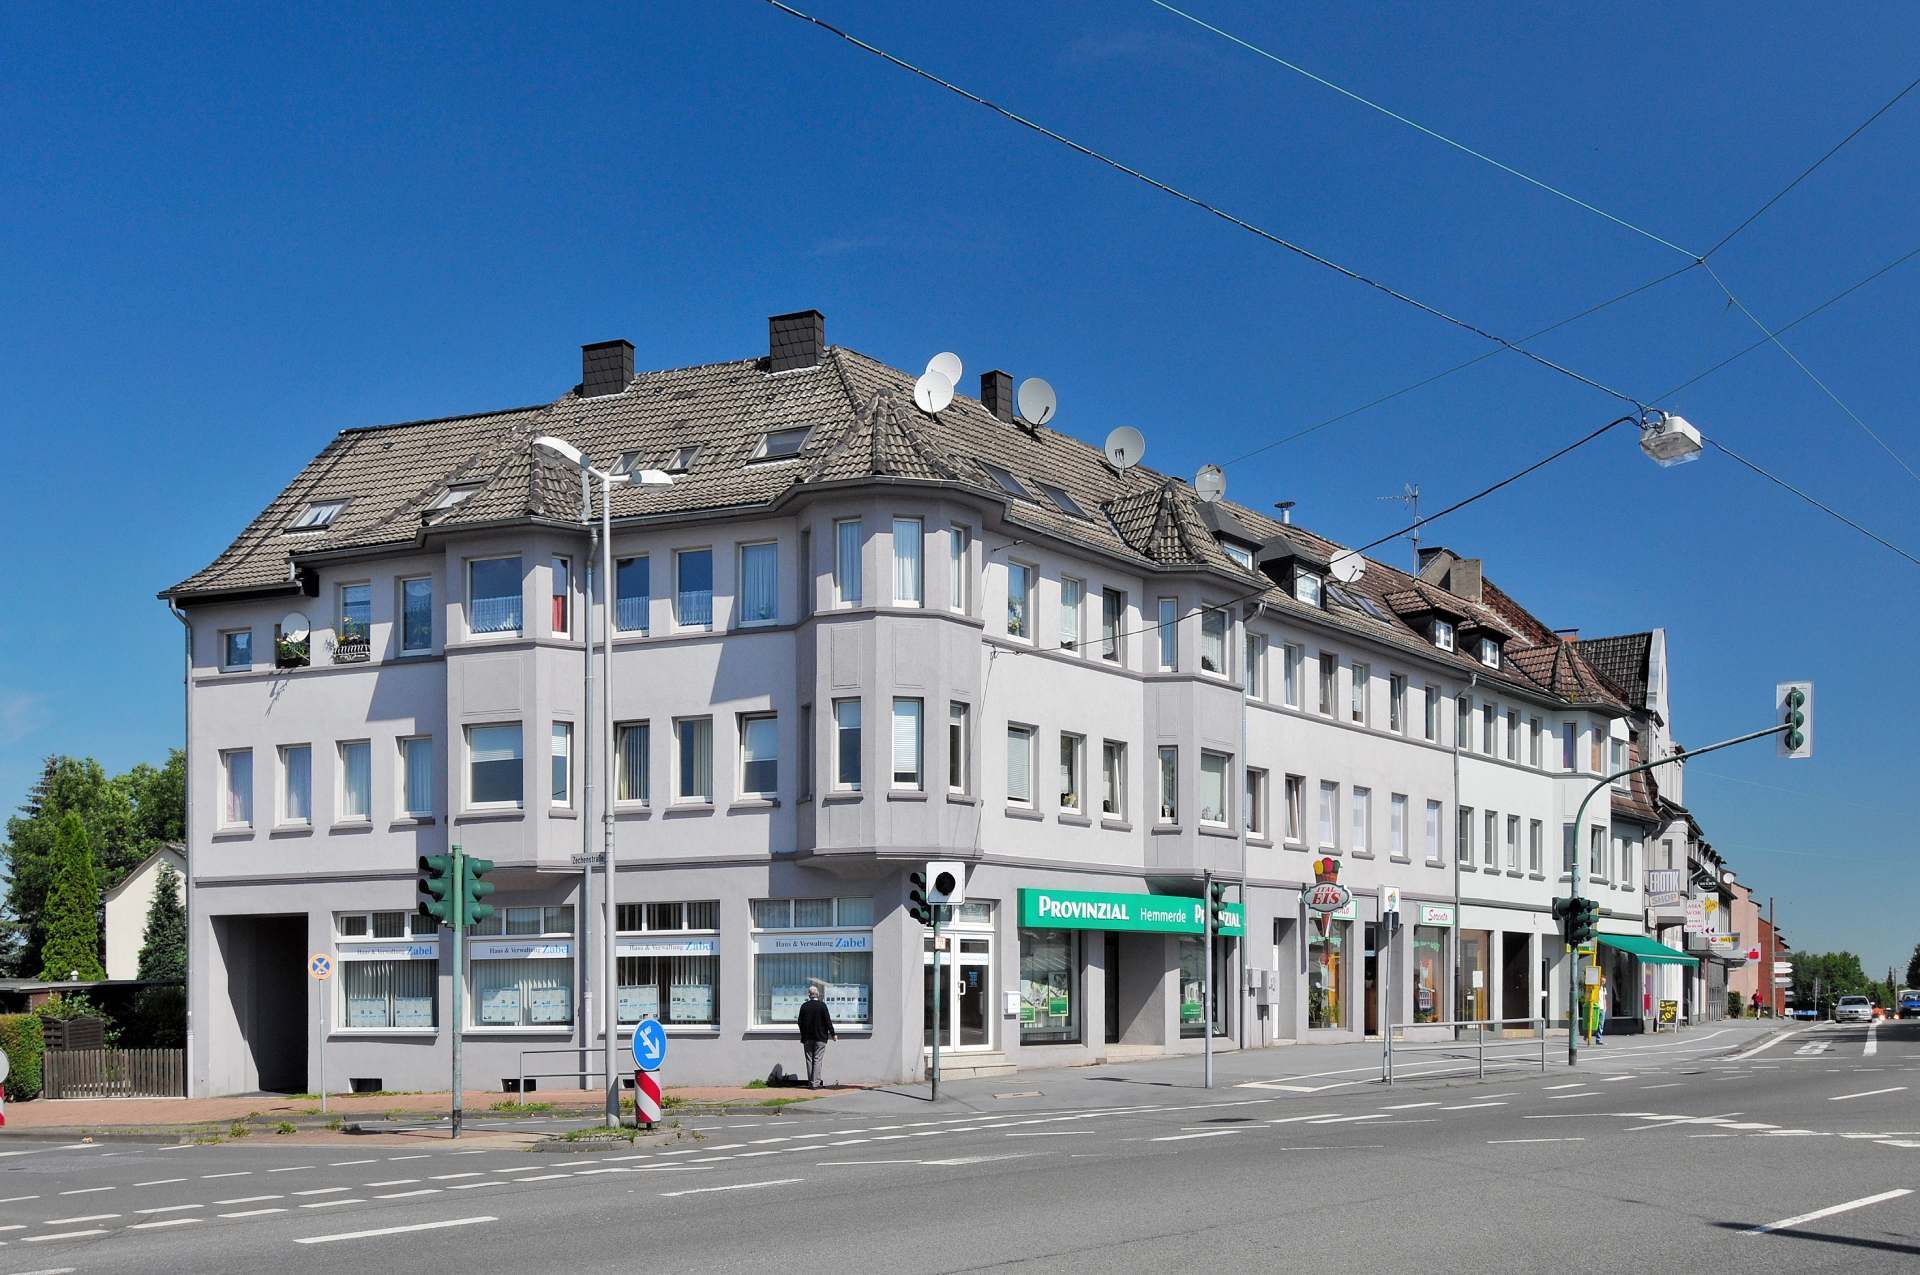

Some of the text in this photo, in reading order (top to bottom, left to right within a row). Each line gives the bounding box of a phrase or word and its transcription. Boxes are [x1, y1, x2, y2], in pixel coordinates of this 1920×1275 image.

[1650, 871, 1679, 892] EROTIK
[1312, 892, 1341, 905] EIS
[1651, 893, 1677, 905] SHOP
[1039, 895, 1129, 921] PROVINZIAL
[1140, 908, 1186, 923] Hemmerde
[541, 943, 568, 953] Zabel
[686, 941, 714, 951] Zabel
[776, 940, 791, 948] Haus
[800, 938, 834, 948] Verwaltung
[835, 936, 866, 949] Zabel
[407, 945, 432, 956] Zabel
